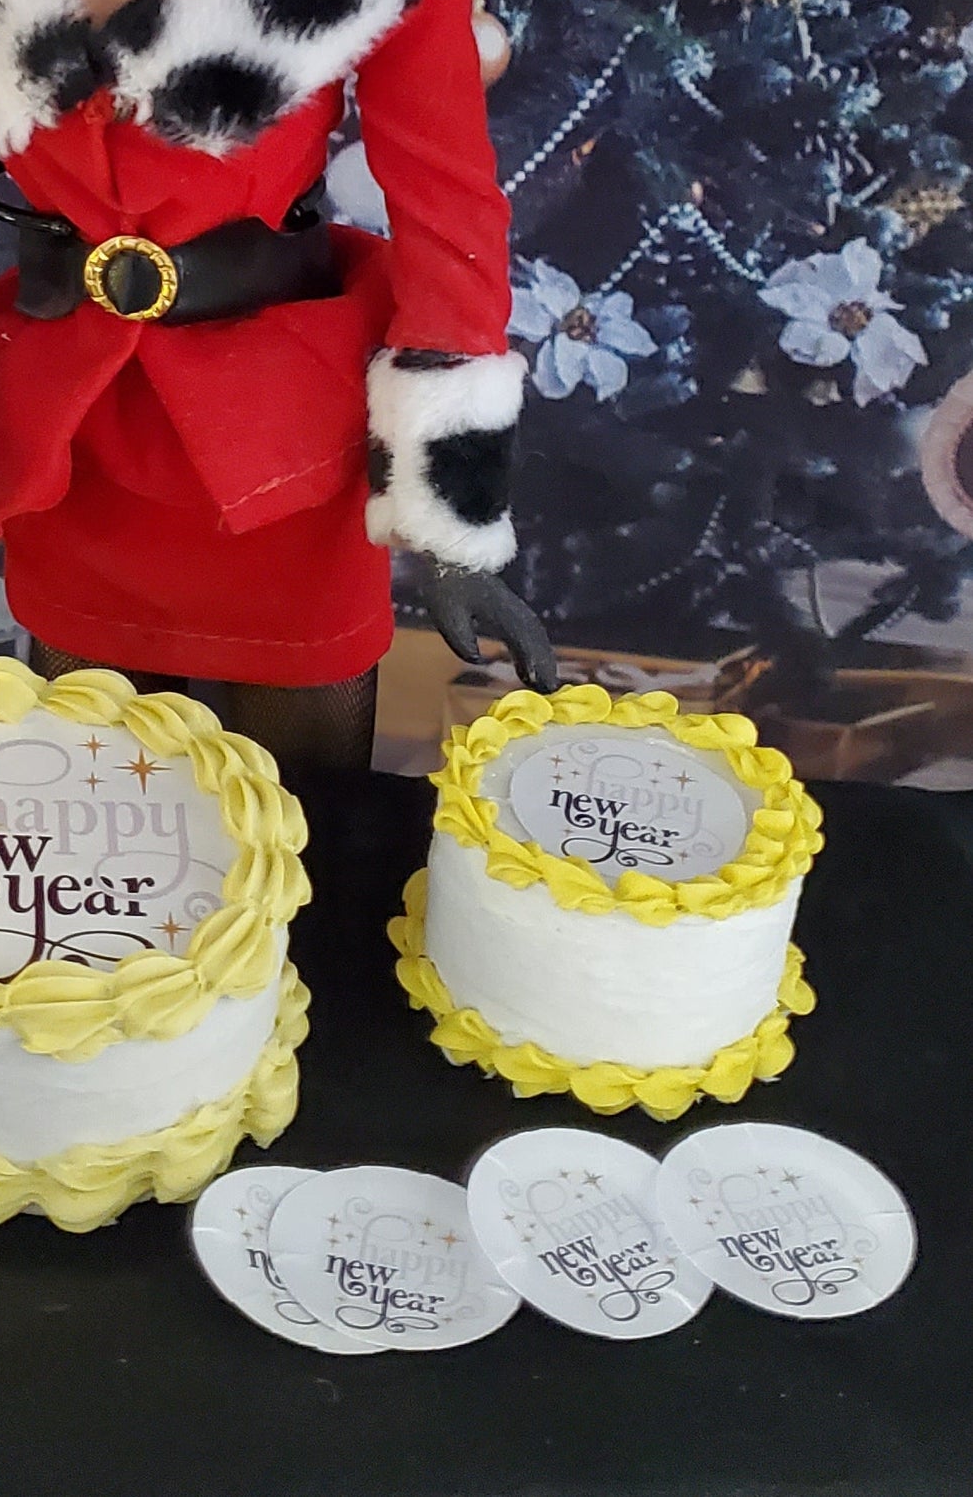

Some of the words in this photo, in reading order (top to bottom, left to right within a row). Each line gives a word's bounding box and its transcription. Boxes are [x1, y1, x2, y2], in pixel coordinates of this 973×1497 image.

[549, 789, 629, 828] new
[593, 816, 680, 863] year
[537, 1234, 599, 1287] new
[717, 1226, 784, 1272] new
[771, 1238, 847, 1303] year
[324, 1253, 398, 1296] new
[588, 1239, 661, 1313] year
[364, 1283, 445, 1329] year
